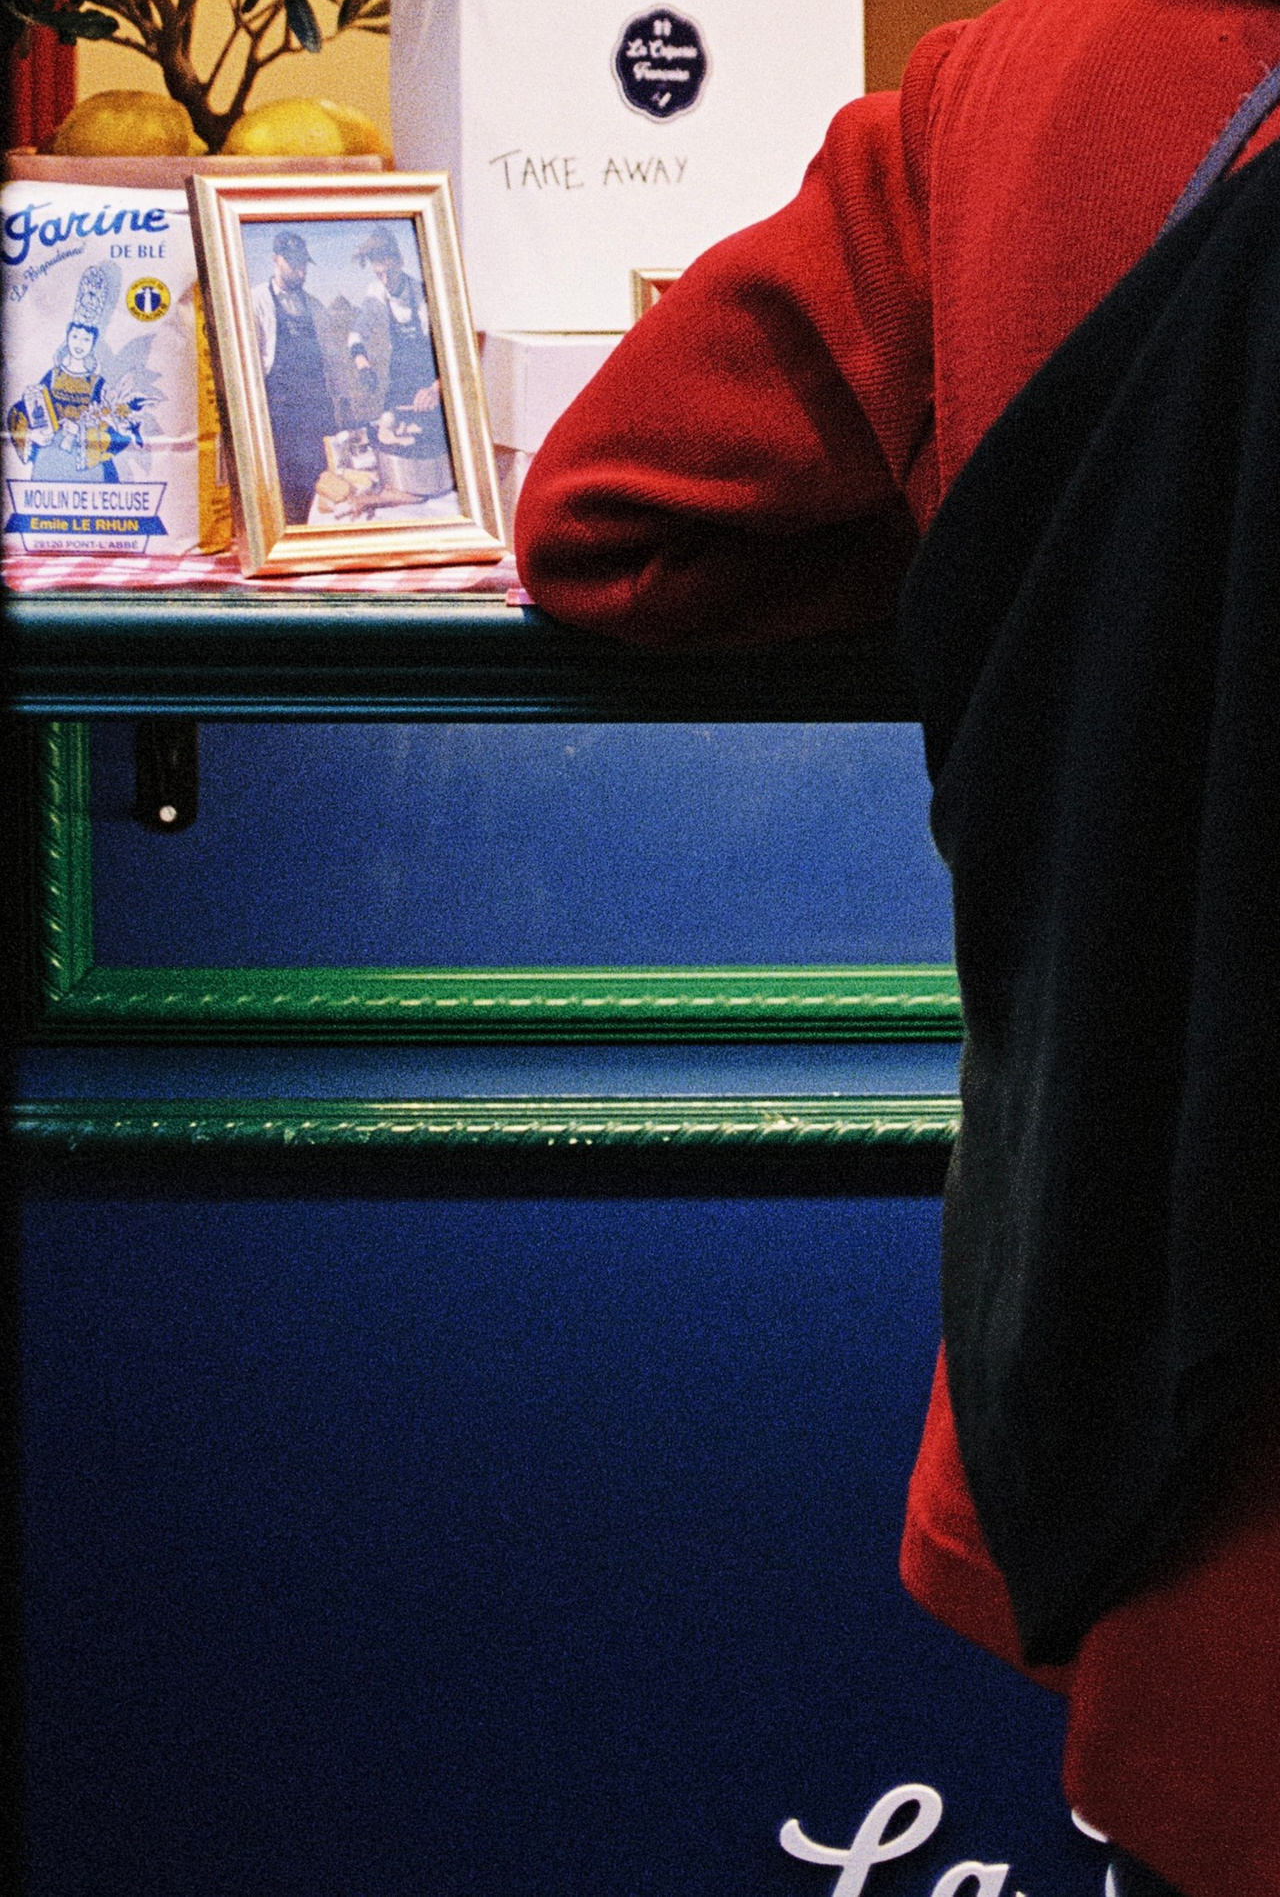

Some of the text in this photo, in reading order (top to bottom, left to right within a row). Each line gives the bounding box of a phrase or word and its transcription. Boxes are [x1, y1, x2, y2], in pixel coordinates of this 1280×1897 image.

[488, 149, 689, 191] TAKE AWAY
[1, 202, 170, 266] Farine
[110, 241, 167, 259] DE BLÉ
[24, 489, 69, 509] MOULIN
[73, 490, 89, 509] DE
[73, 518, 91, 531] LE
[95, 518, 139, 532] RHUN
